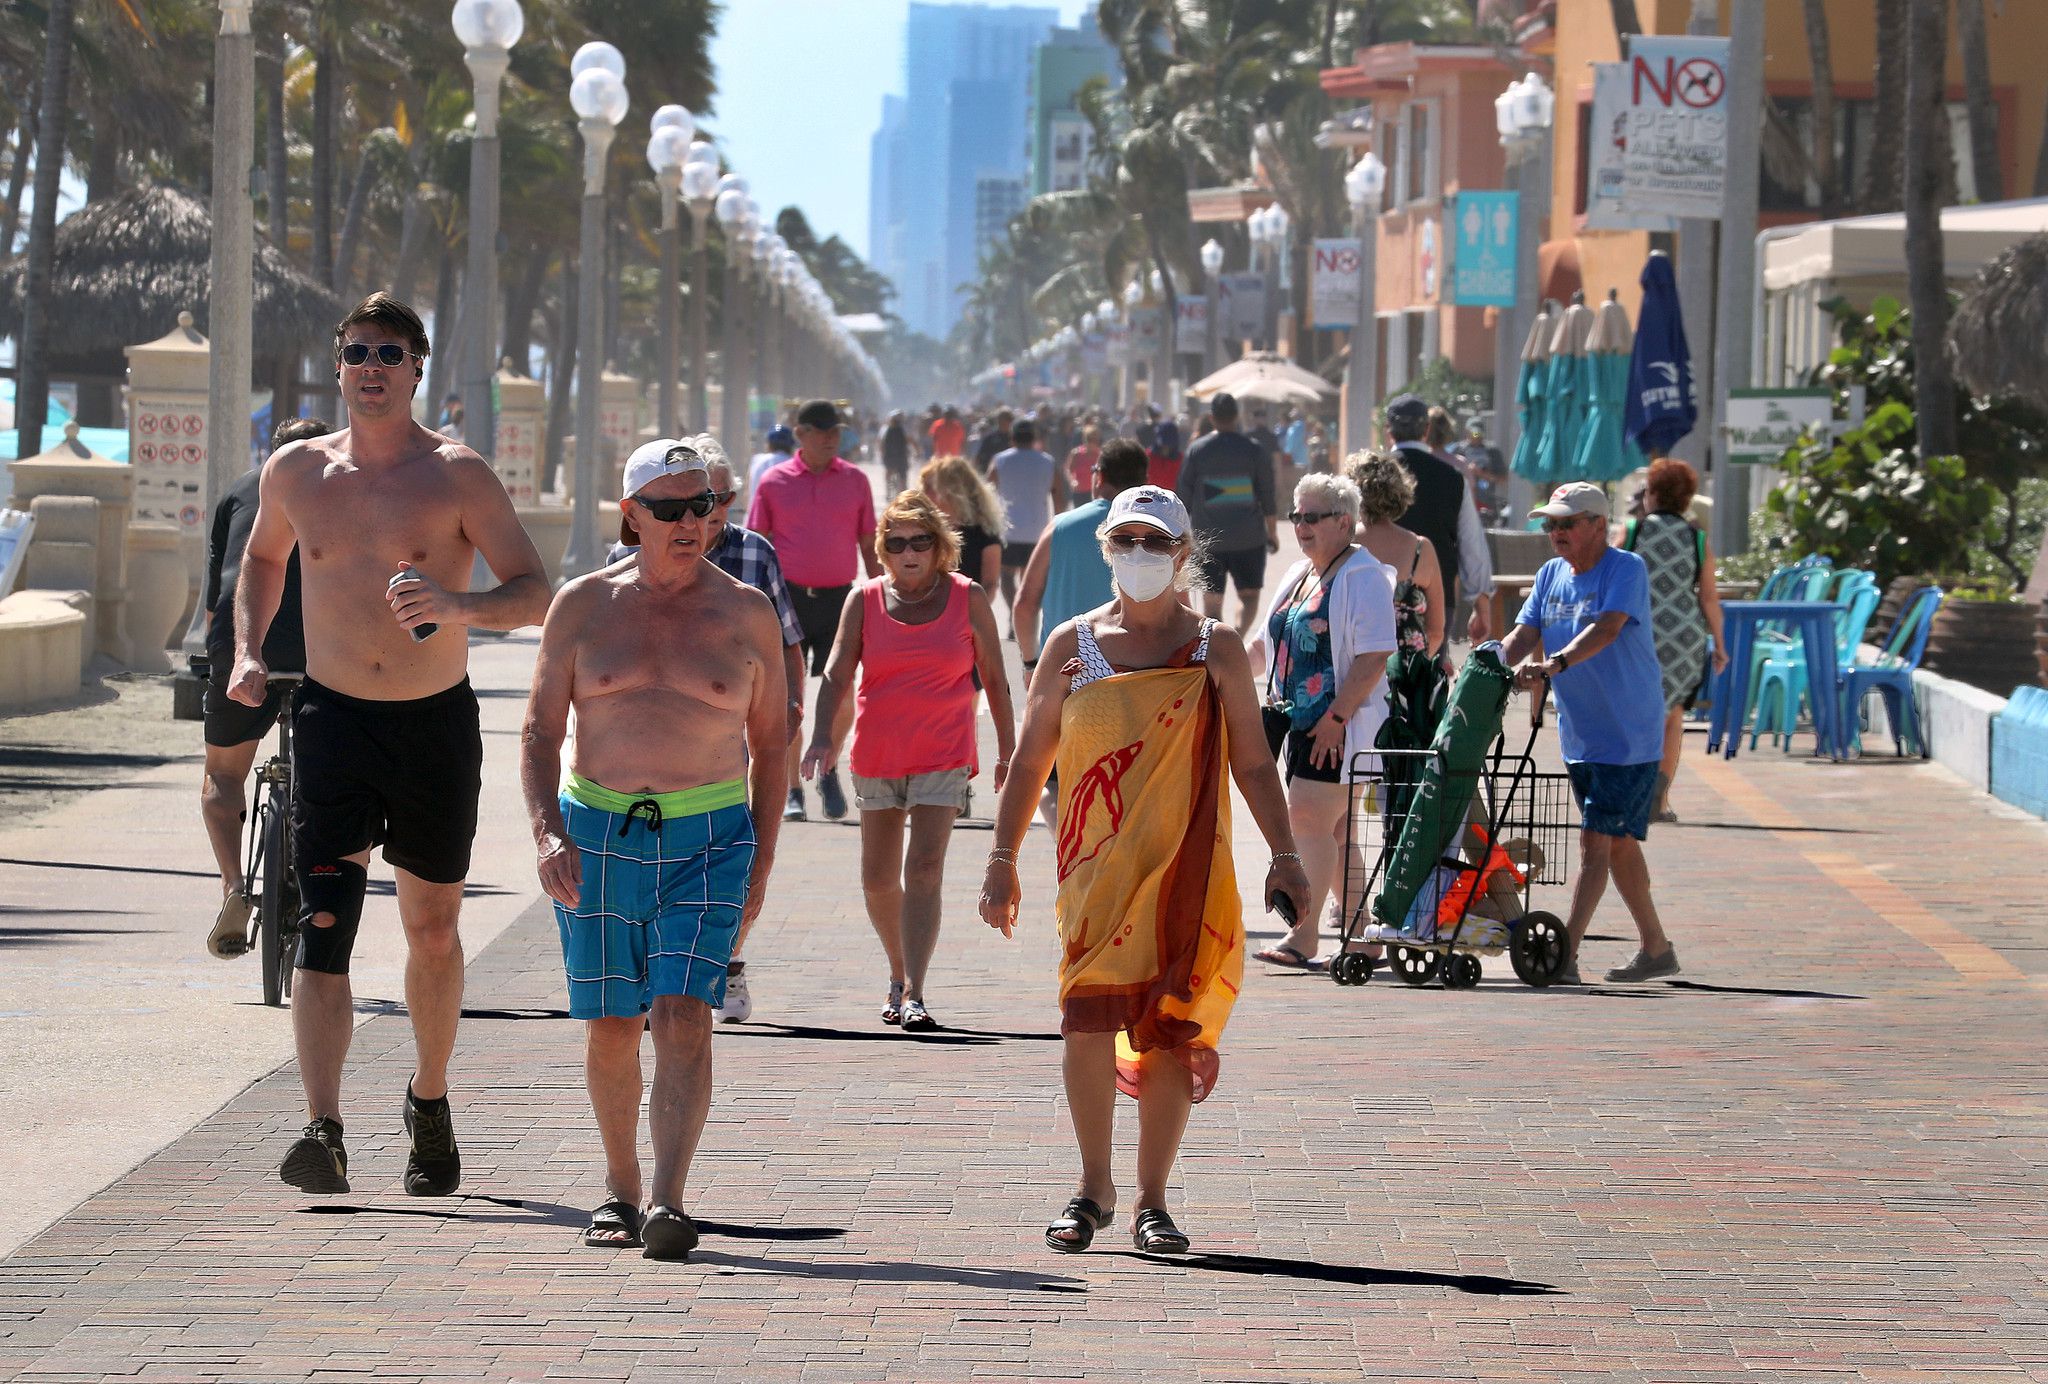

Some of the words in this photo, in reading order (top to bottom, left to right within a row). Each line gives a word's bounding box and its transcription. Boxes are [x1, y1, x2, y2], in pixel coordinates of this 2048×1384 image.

[1632, 55, 1725, 109] NO
[1632, 111, 1726, 141] PETS
[1315, 248, 1362, 274] NO
[1394, 813, 1423, 890] SPORTS
